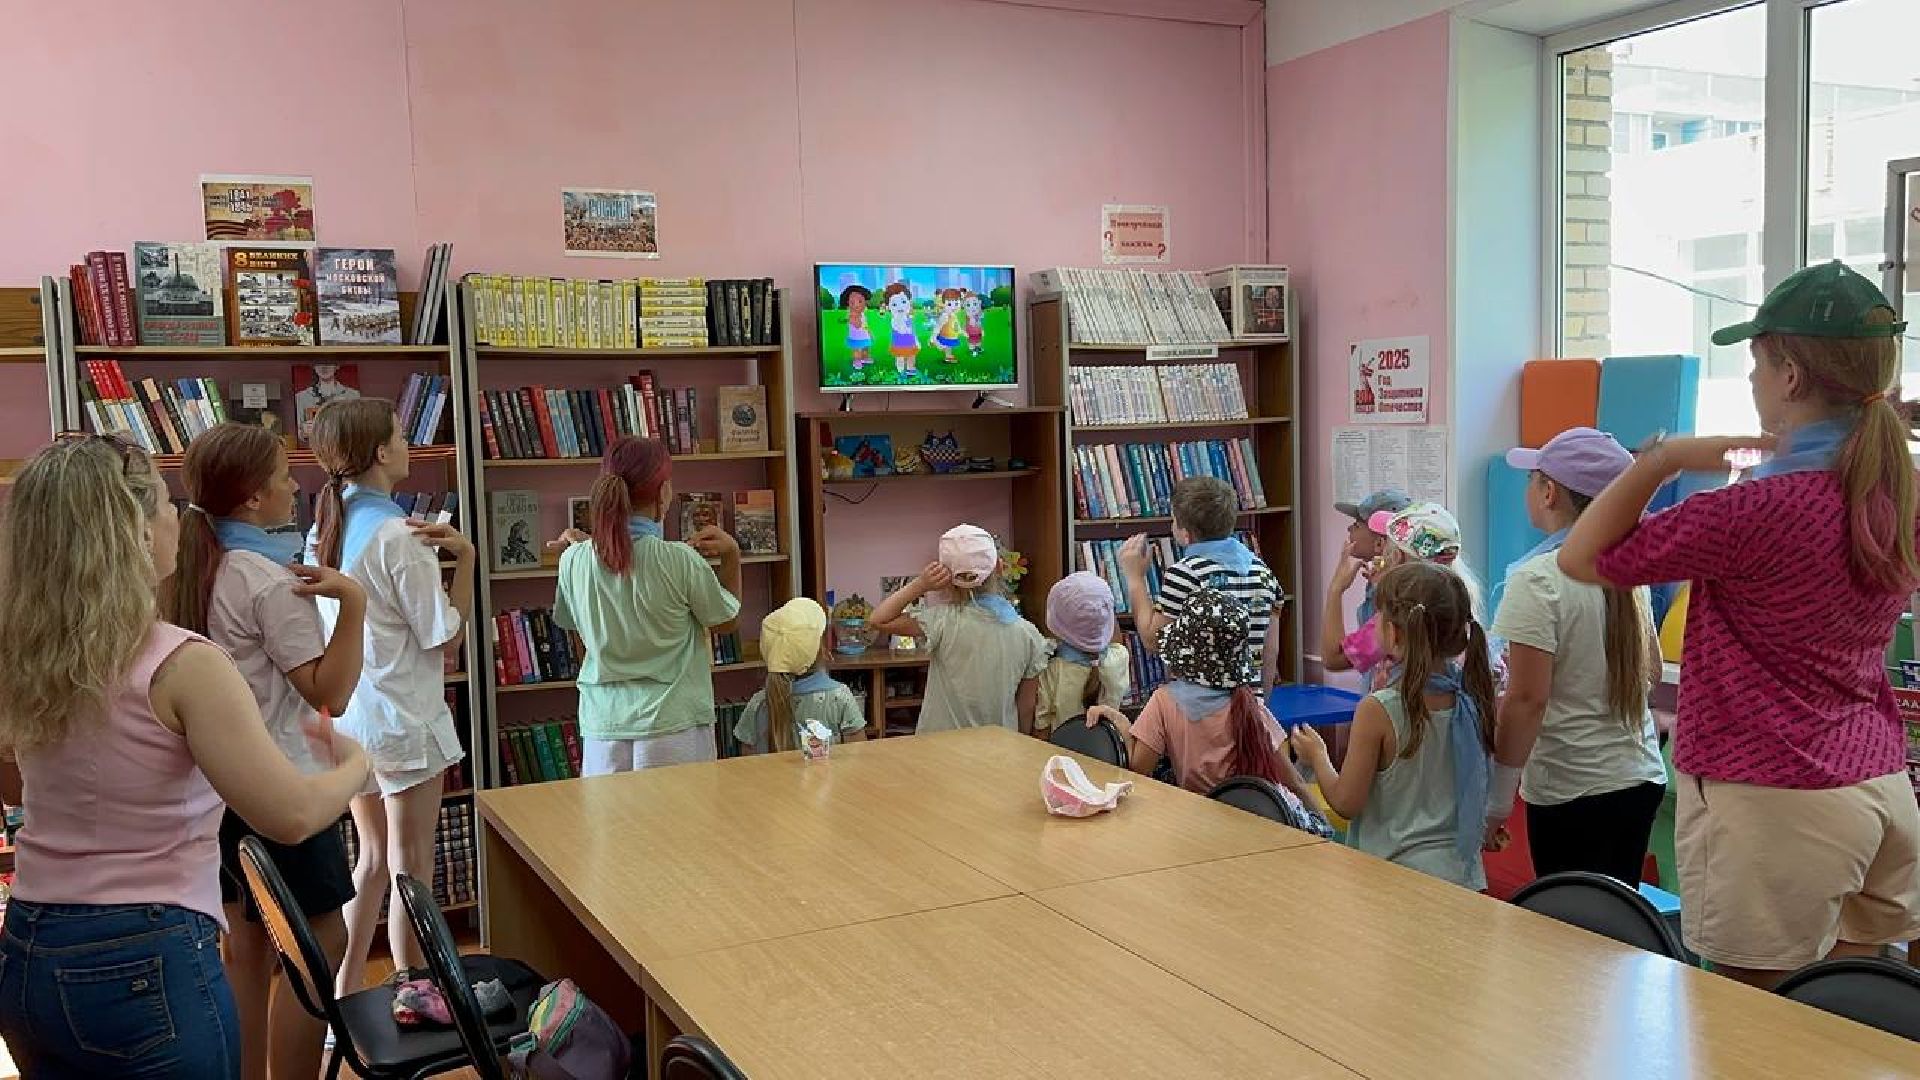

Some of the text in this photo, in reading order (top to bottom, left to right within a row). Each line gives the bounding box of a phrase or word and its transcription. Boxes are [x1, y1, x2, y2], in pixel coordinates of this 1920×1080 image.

[335, 258, 374, 271] ГЕРОИ
[326, 273, 385, 283] МОСКОВСКОЙ
[1378, 348, 1410, 370] 2025
